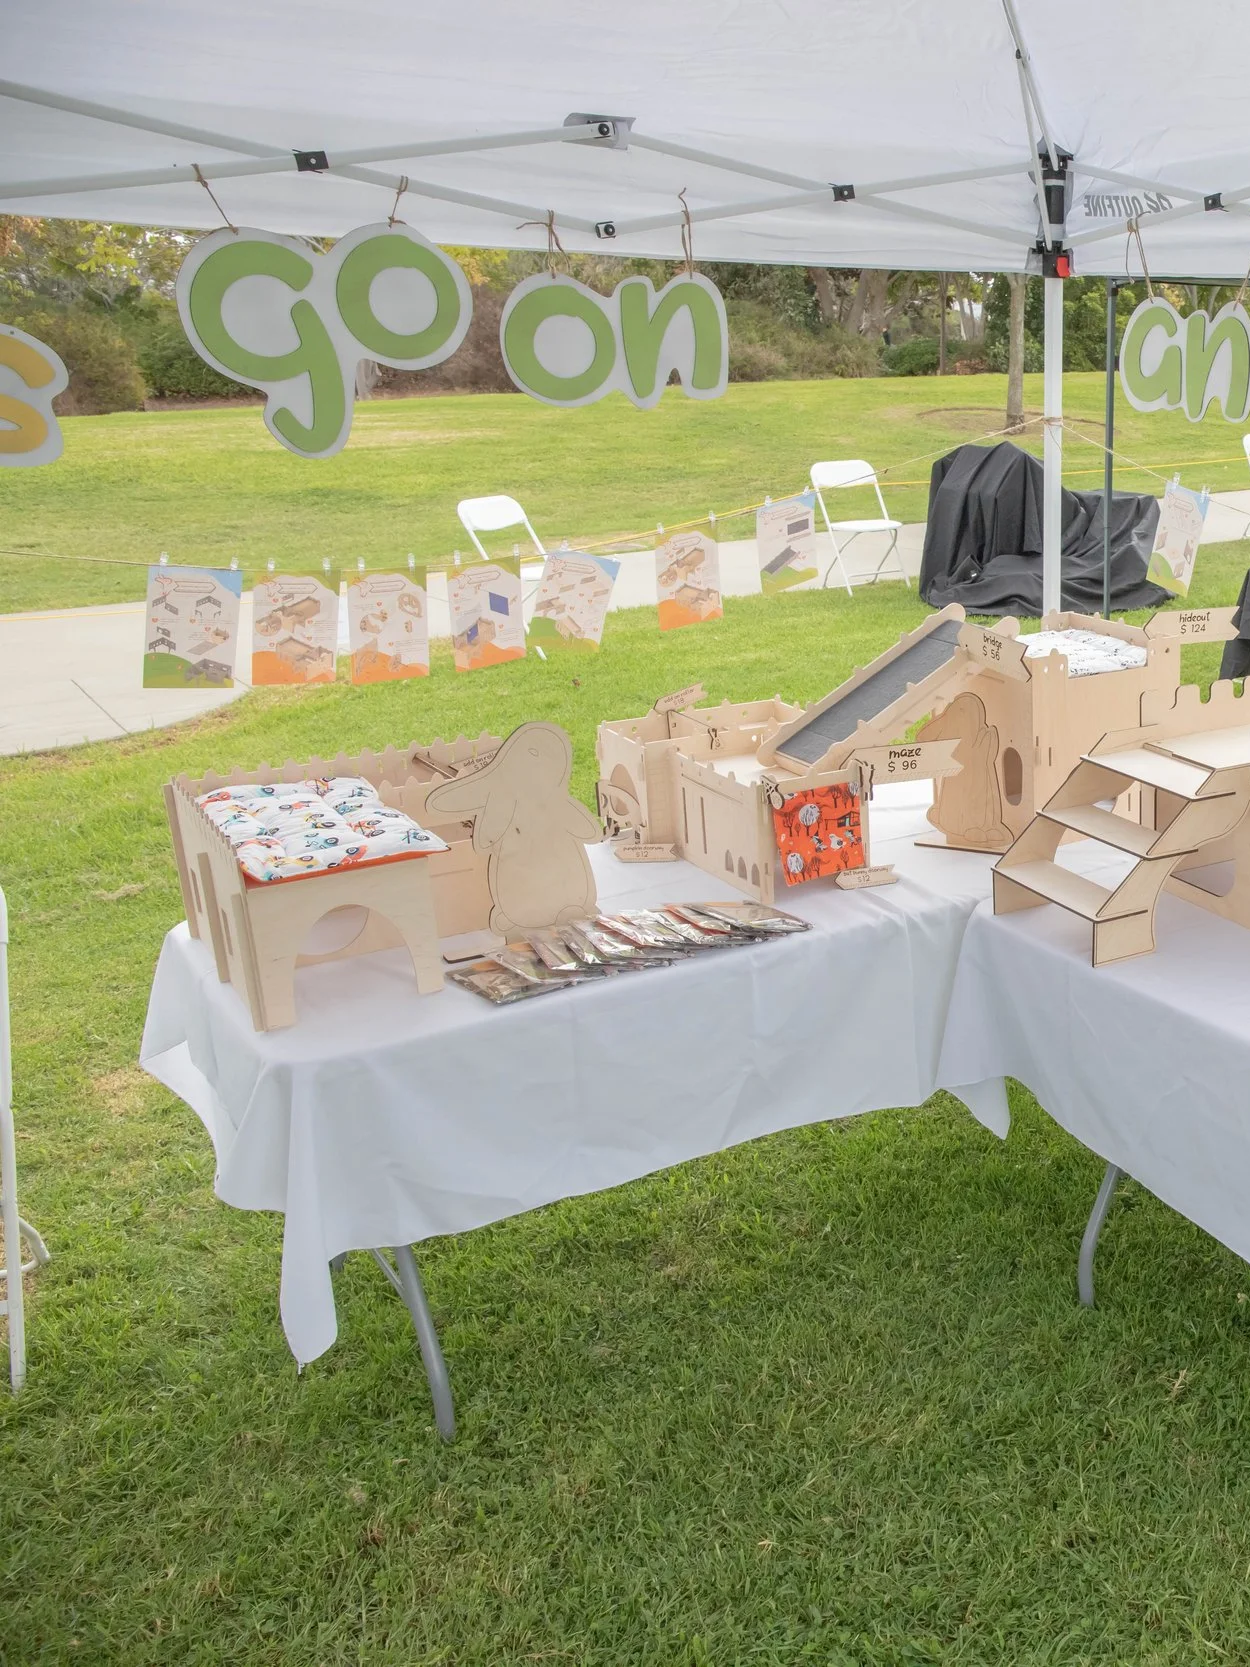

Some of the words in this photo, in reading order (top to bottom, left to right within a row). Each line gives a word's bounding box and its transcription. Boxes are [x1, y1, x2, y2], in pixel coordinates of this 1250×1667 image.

[189, 234, 462, 453] go
[505, 282, 718, 400] on
[1125, 307, 1250, 420] an
[1179, 611, 1211, 623] hideout
[1180, 623, 1187, 635] $
[1191, 623, 1206, 633] 124
[983, 632, 1003, 651] bridge
[990, 648, 1001, 661] 56
[888, 747, 922, 759] maze
[888, 760, 896, 773] $
[902, 760, 917, 770] 96
